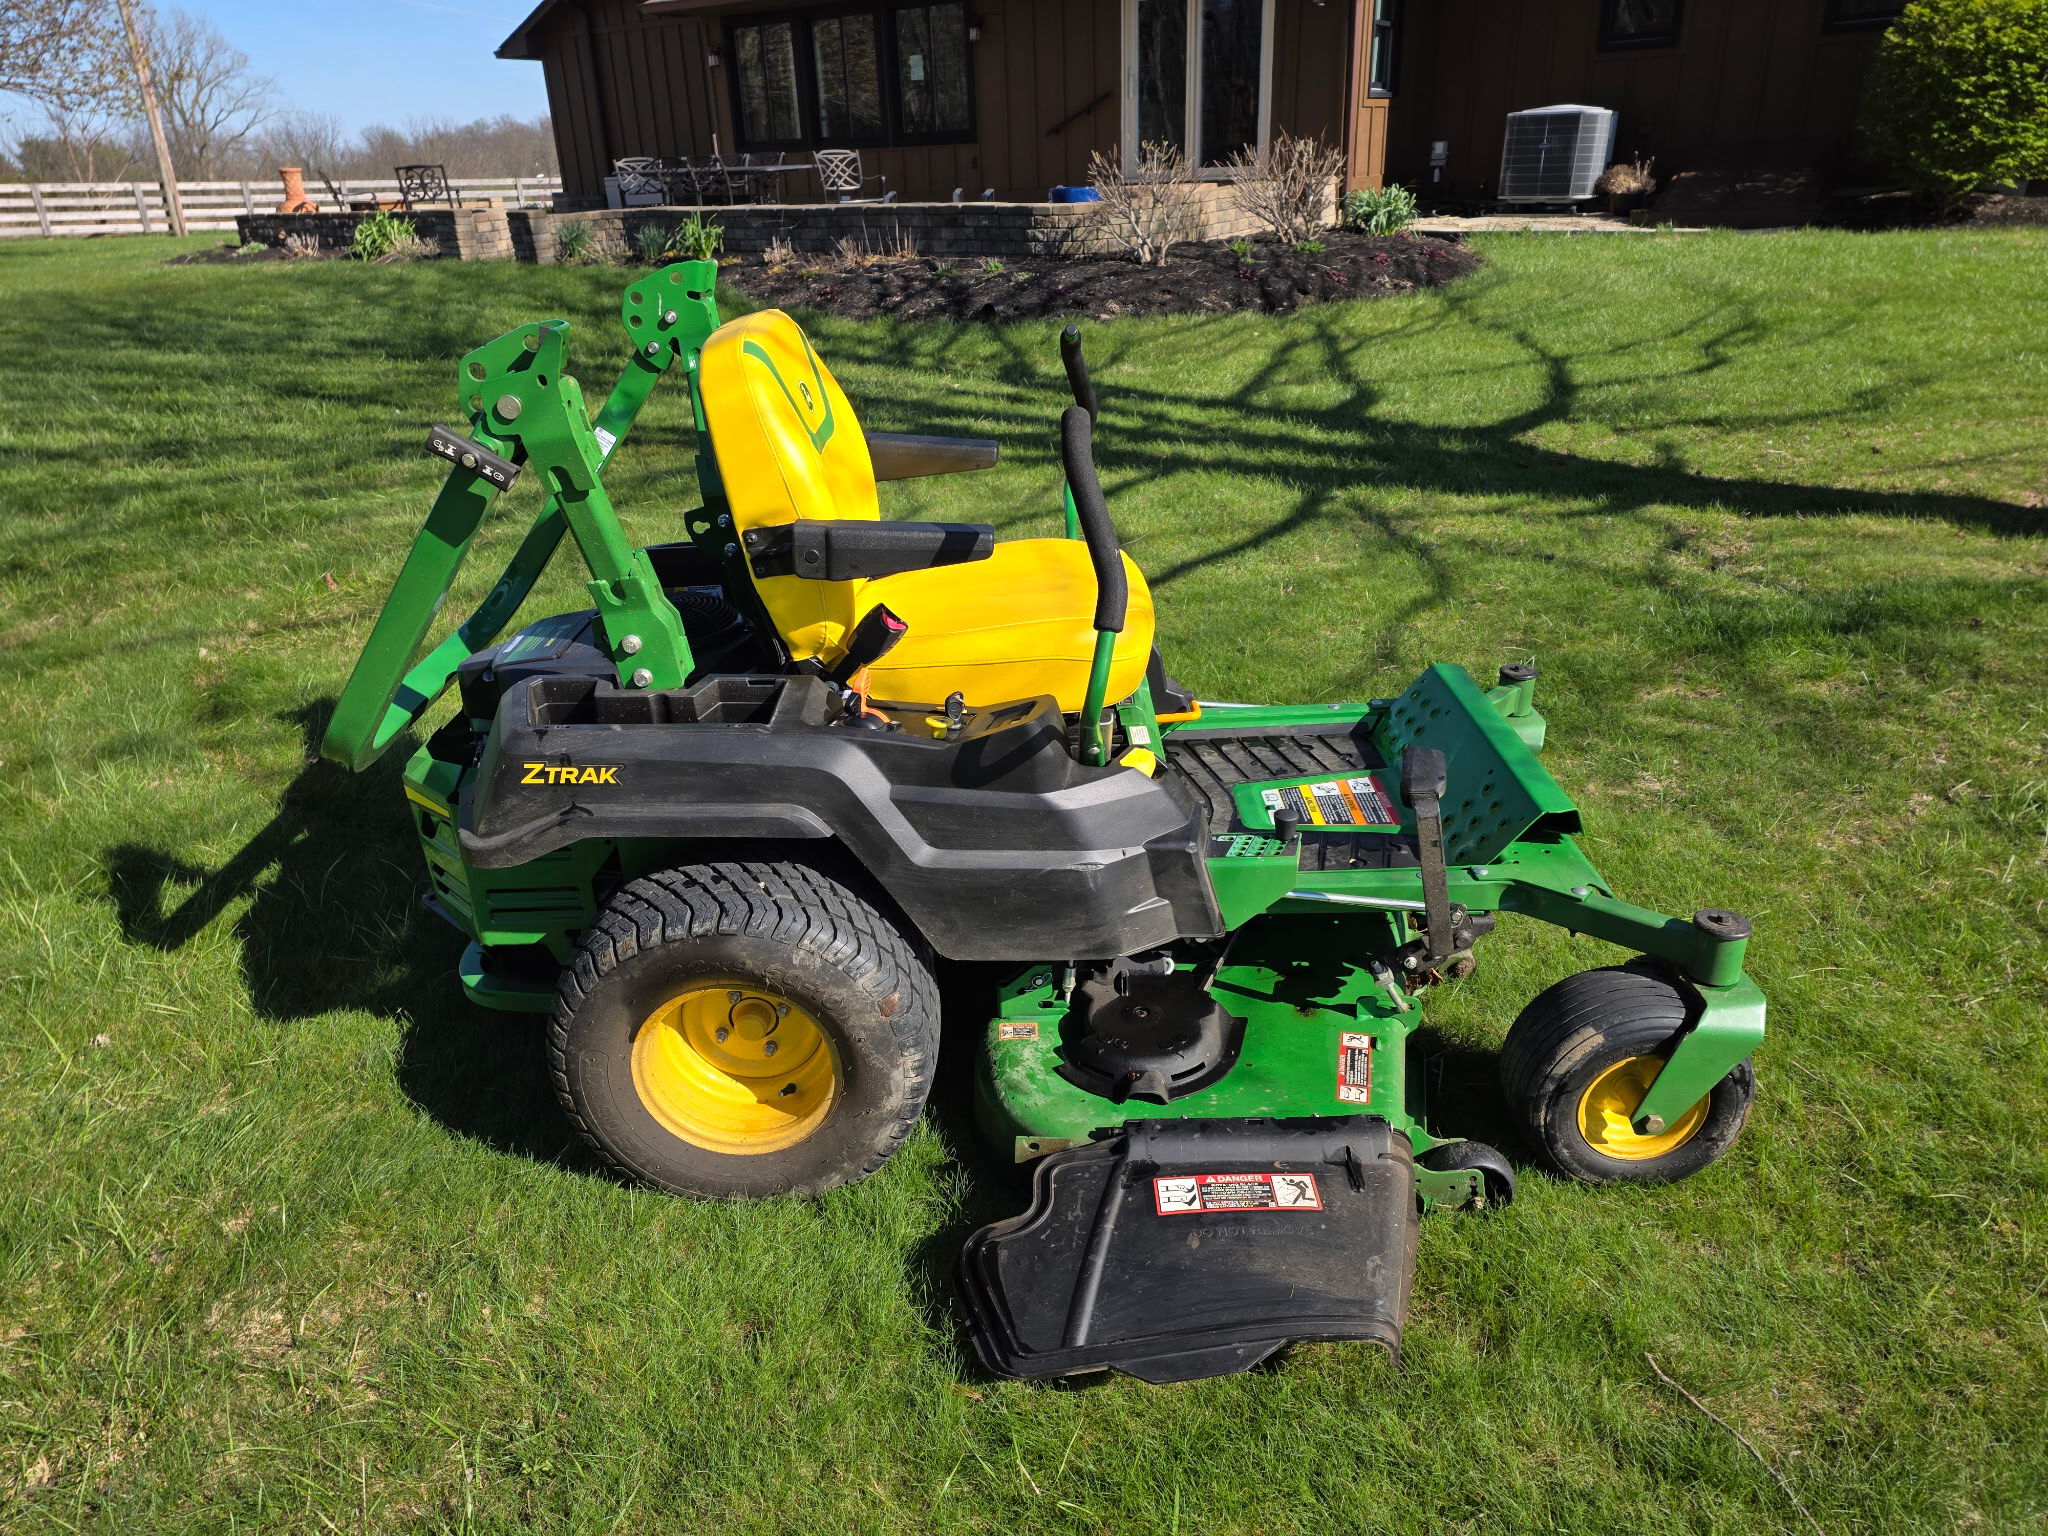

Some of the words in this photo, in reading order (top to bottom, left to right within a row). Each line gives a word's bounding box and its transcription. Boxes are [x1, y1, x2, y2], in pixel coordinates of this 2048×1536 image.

[521, 763, 618, 784] ZTRAK
[1217, 1175, 1263, 1183] DANGER
[1216, 1225, 1246, 1237] NOT
[1250, 1223, 1314, 1236] REMOVE
